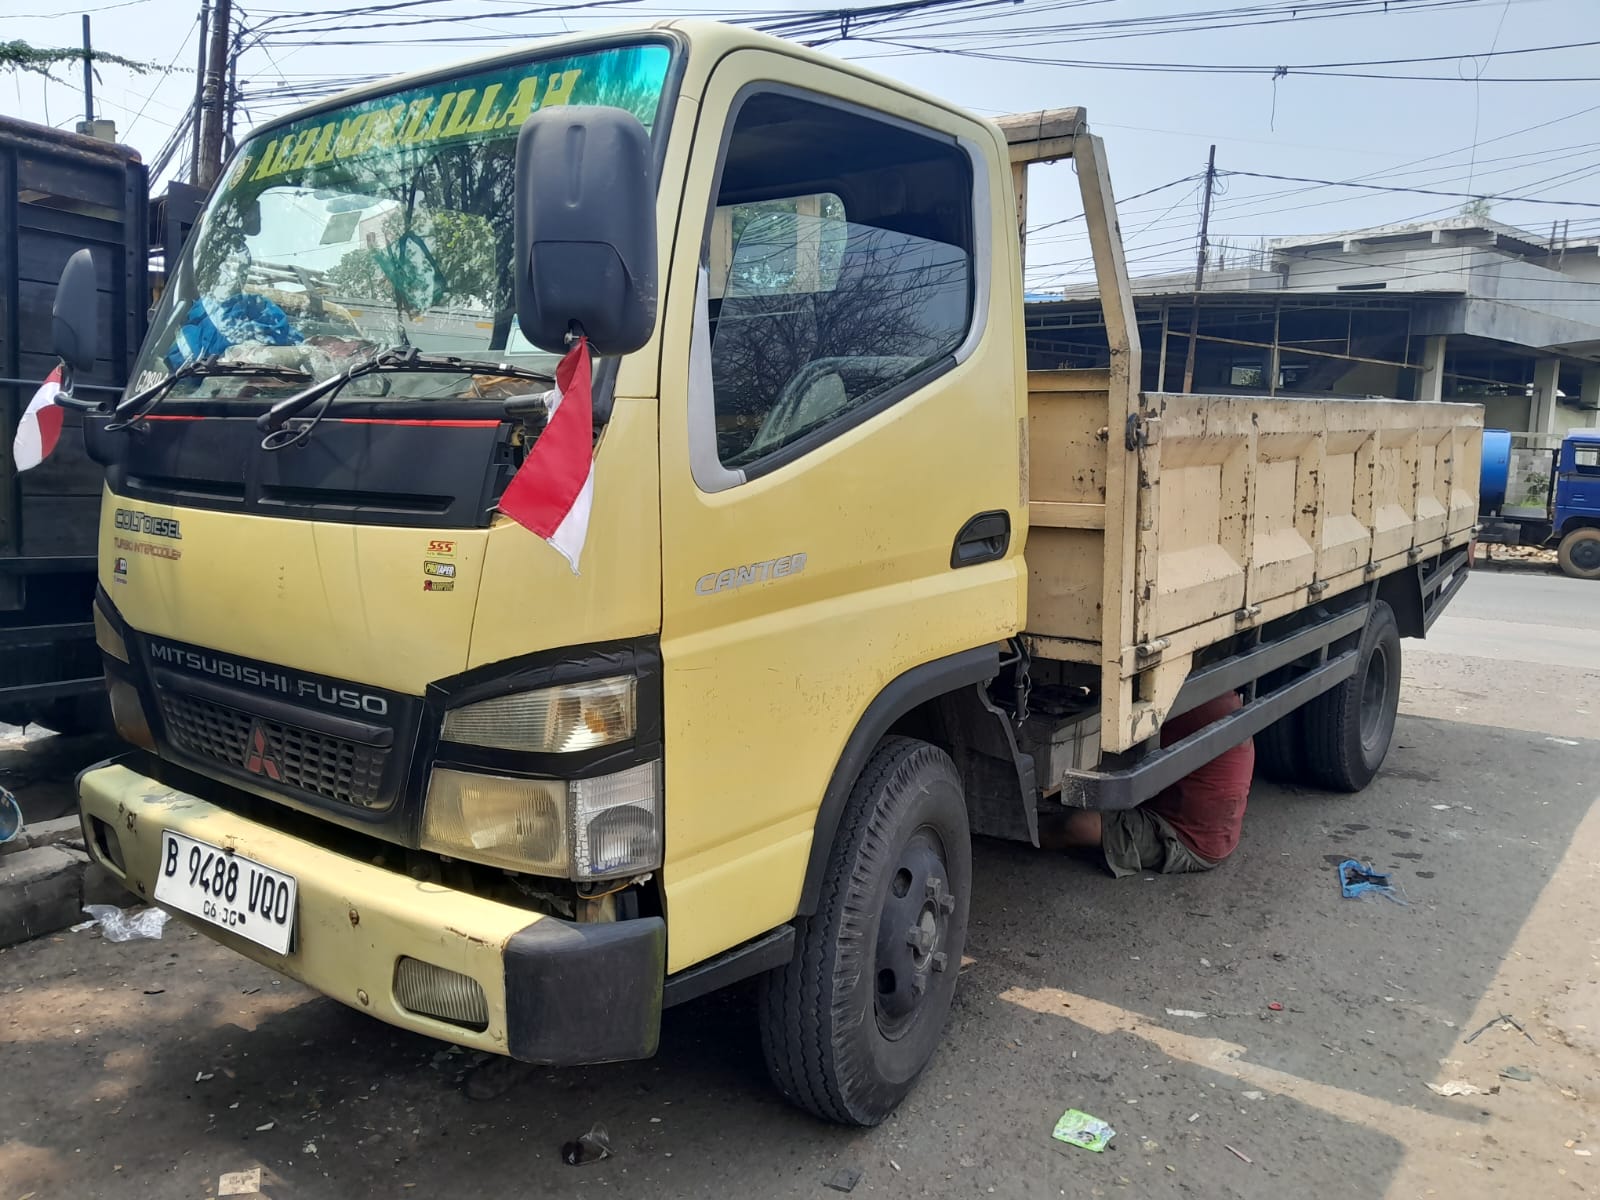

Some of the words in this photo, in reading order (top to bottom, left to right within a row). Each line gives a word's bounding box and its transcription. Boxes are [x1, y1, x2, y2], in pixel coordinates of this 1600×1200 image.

[249, 69, 582, 182] ALHAMDULILLAH
[115, 508, 145, 532] COLT
[143, 515, 183, 540] DIESEL
[427, 540, 455, 553] SSS
[695, 552, 807, 596] CANTER
[151, 642, 288, 693] MITSUBISHI
[297, 679, 388, 716] FUSO
[165, 837, 179, 877] B
[189, 845, 239, 903] 9488
[248, 869, 289, 924] VQO
